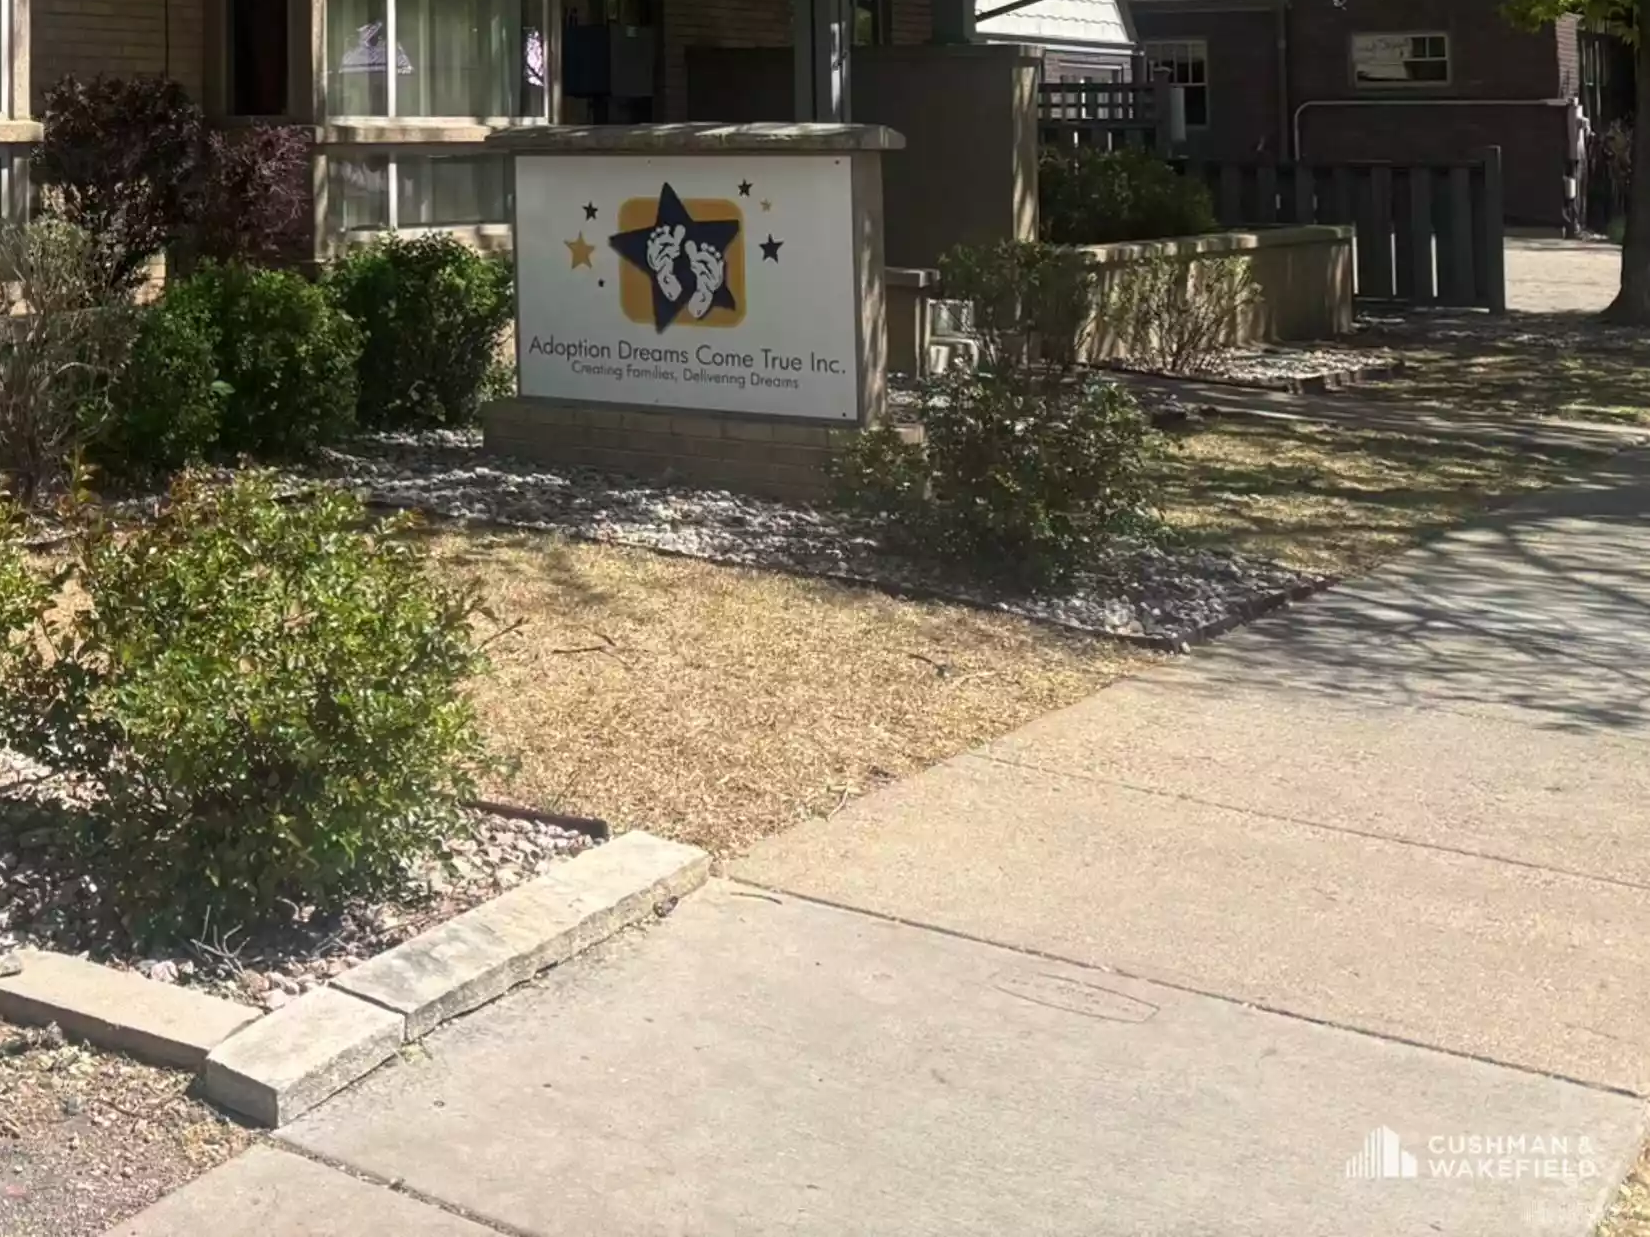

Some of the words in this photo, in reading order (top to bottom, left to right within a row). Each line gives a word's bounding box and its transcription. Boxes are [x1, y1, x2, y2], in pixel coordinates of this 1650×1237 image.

[529, 335, 611, 362] Adoption
[618, 340, 689, 364] Dreams
[696, 344, 754, 367] Come
[761, 348, 803, 372] True
[811, 351, 846, 375] Inc.
[571, 360, 623, 381] Creating
[627, 364, 678, 383] Families,
[683, 368, 746, 390] Delivering
[750, 372, 799, 389] Dreams
